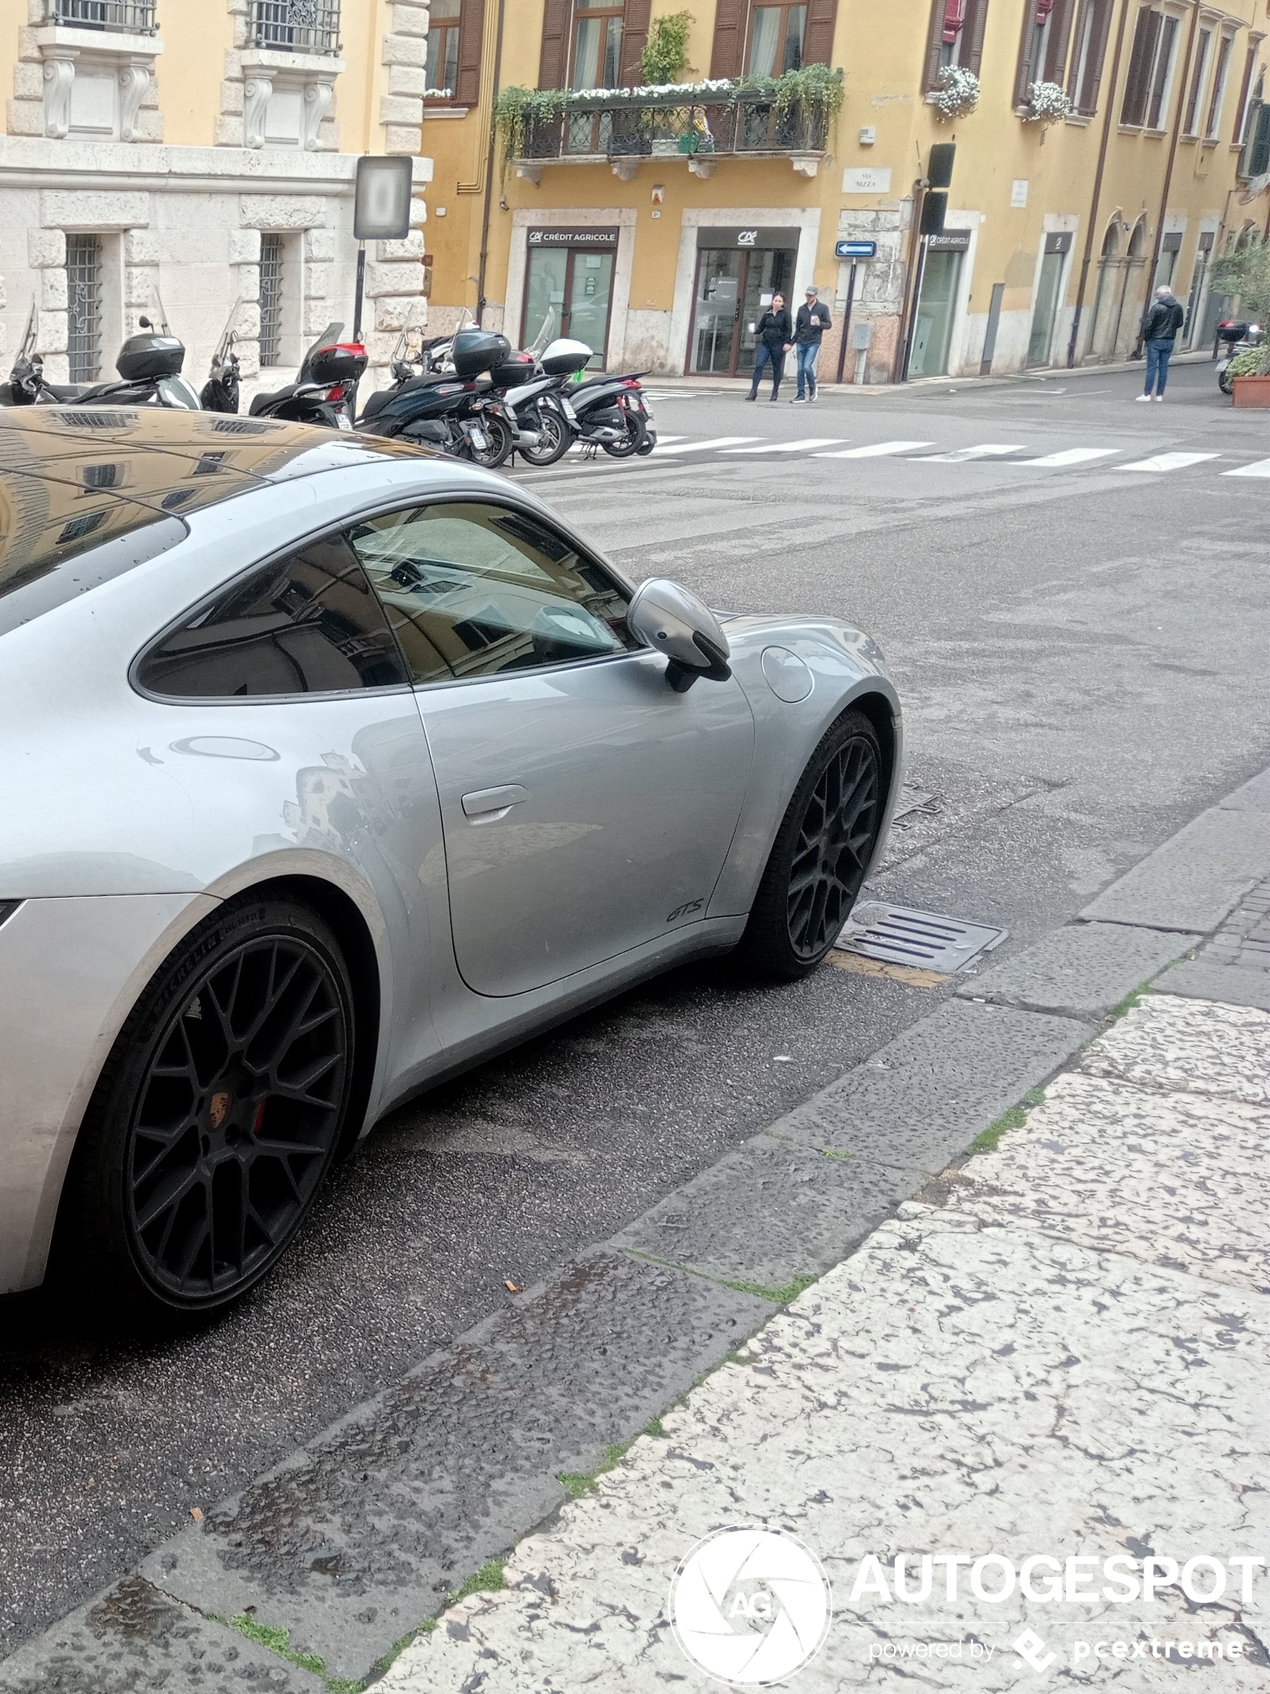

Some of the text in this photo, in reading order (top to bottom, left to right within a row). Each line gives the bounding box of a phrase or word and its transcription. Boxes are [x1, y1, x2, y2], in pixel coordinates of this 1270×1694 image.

[543, 232, 573, 241] CRÉDIT
[573, 233, 616, 242] AGRICOLE
[666, 898, 705, 923] GTS
[153, 931, 220, 1017] MICHELIN
